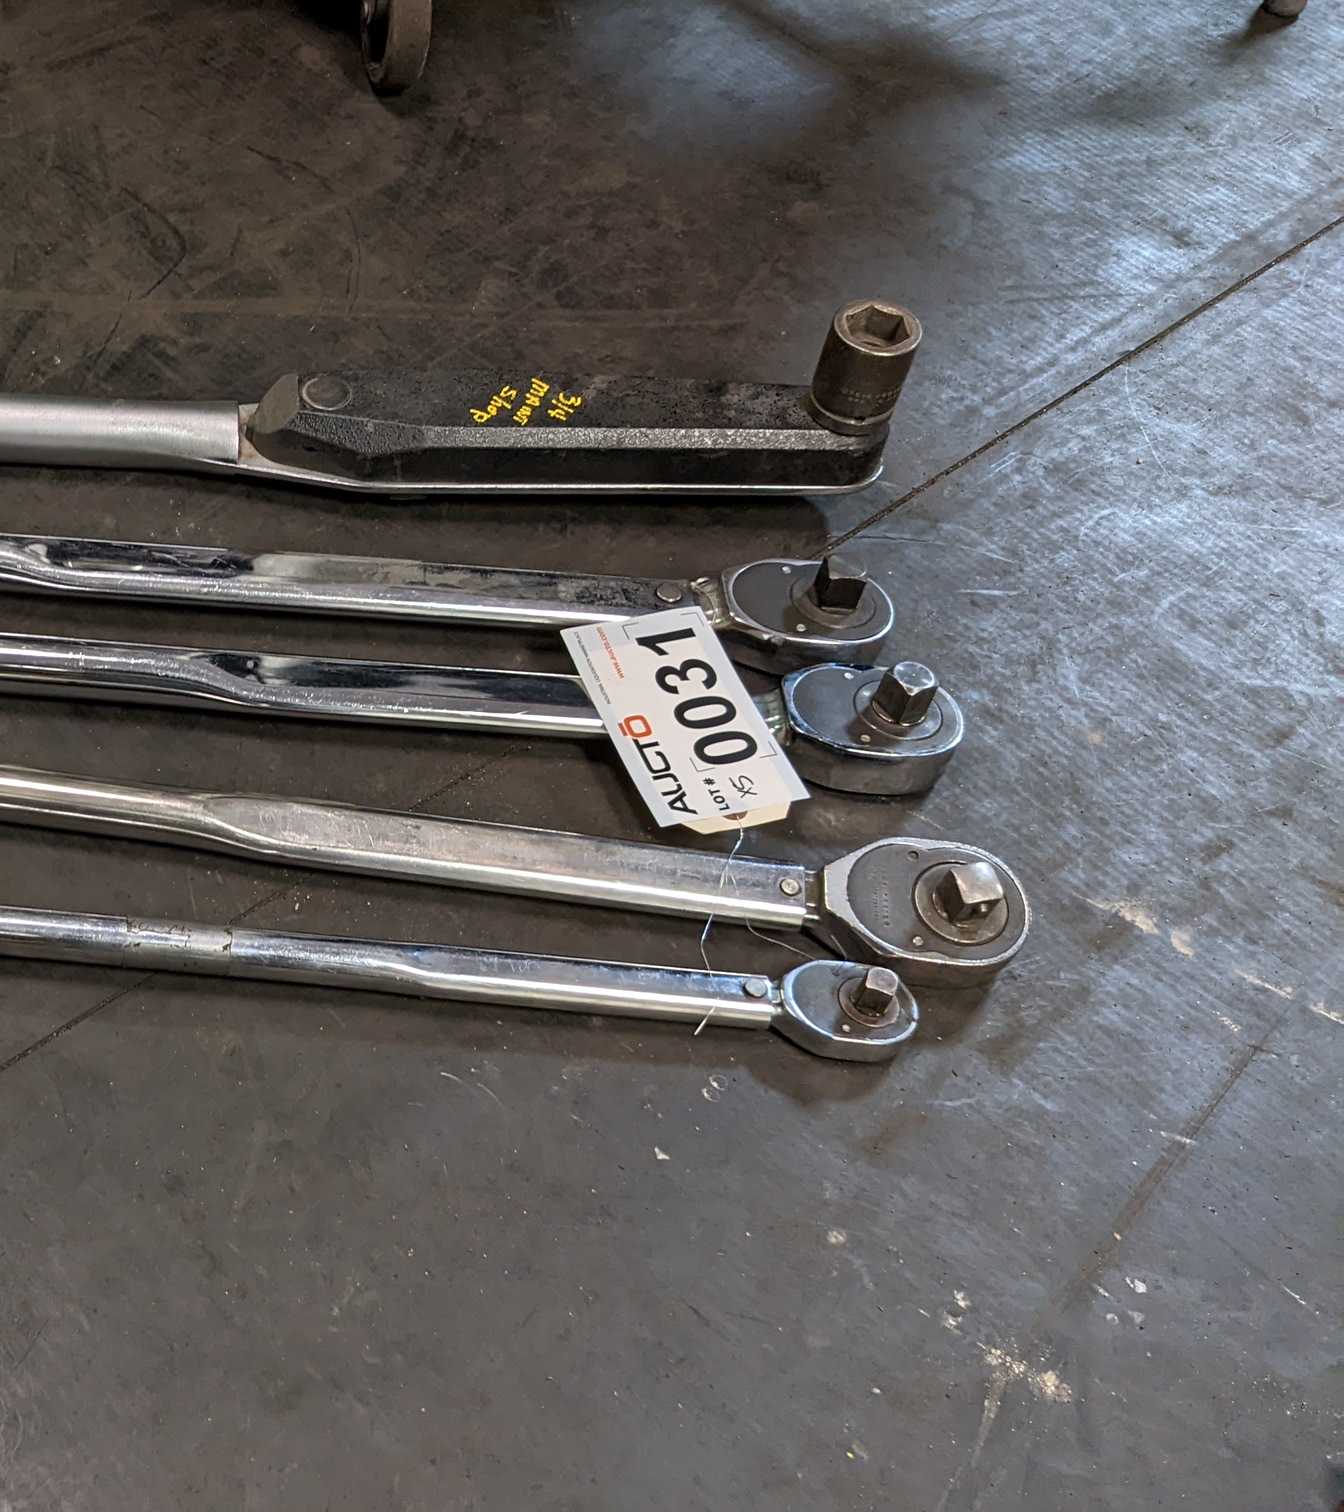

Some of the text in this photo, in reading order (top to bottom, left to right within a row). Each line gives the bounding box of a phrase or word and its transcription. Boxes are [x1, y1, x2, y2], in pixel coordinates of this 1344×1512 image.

[635, 627, 758, 766] 0031
[703, 777, 731, 812] LOT #
